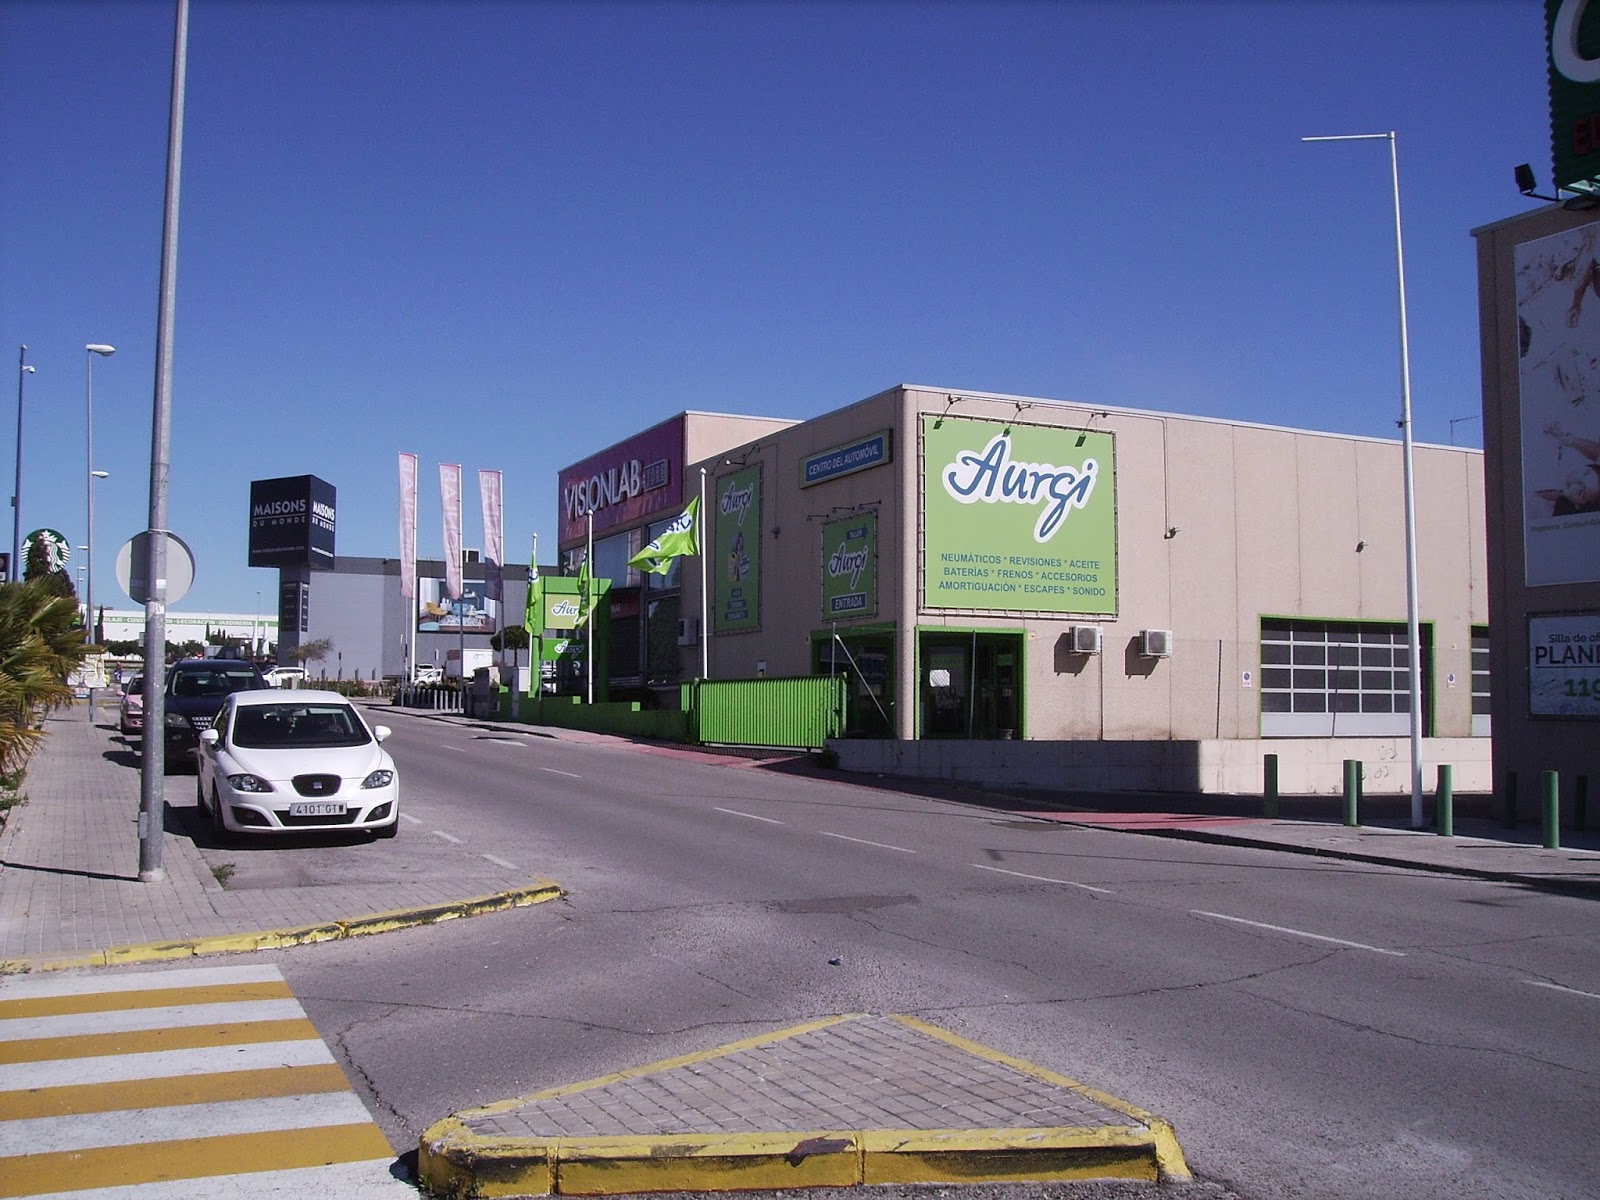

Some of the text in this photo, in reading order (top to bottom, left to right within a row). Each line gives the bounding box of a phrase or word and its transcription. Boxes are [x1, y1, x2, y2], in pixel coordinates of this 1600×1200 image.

[809, 459, 832, 475] CENTRO
[832, 457, 843, 468] DEL
[564, 459, 641, 519] VISIONLAB
[946, 438, 1095, 539] Aurgi
[253, 499, 306, 516] MAISONS
[312, 501, 335, 521] MAISONS
[721, 481, 753, 525] Aurgi
[272, 516, 306, 525] MONDE
[829, 543, 867, 588] Aurgi
[941, 552, 1100, 569] NEUMÁTICOS REVISIONES ACEITE
[944, 566, 1098, 583] BATERÍAS FRENOS ACCESORIOS
[938, 580, 1106, 597] AMORTIGUACIÓN ESCAPES SONIDO
[835, 596, 863, 609] ENTRADA
[1548, 633, 1570, 643] Silla
[1572, 633, 1586, 643] de
[296, 804, 321, 814] 4101
